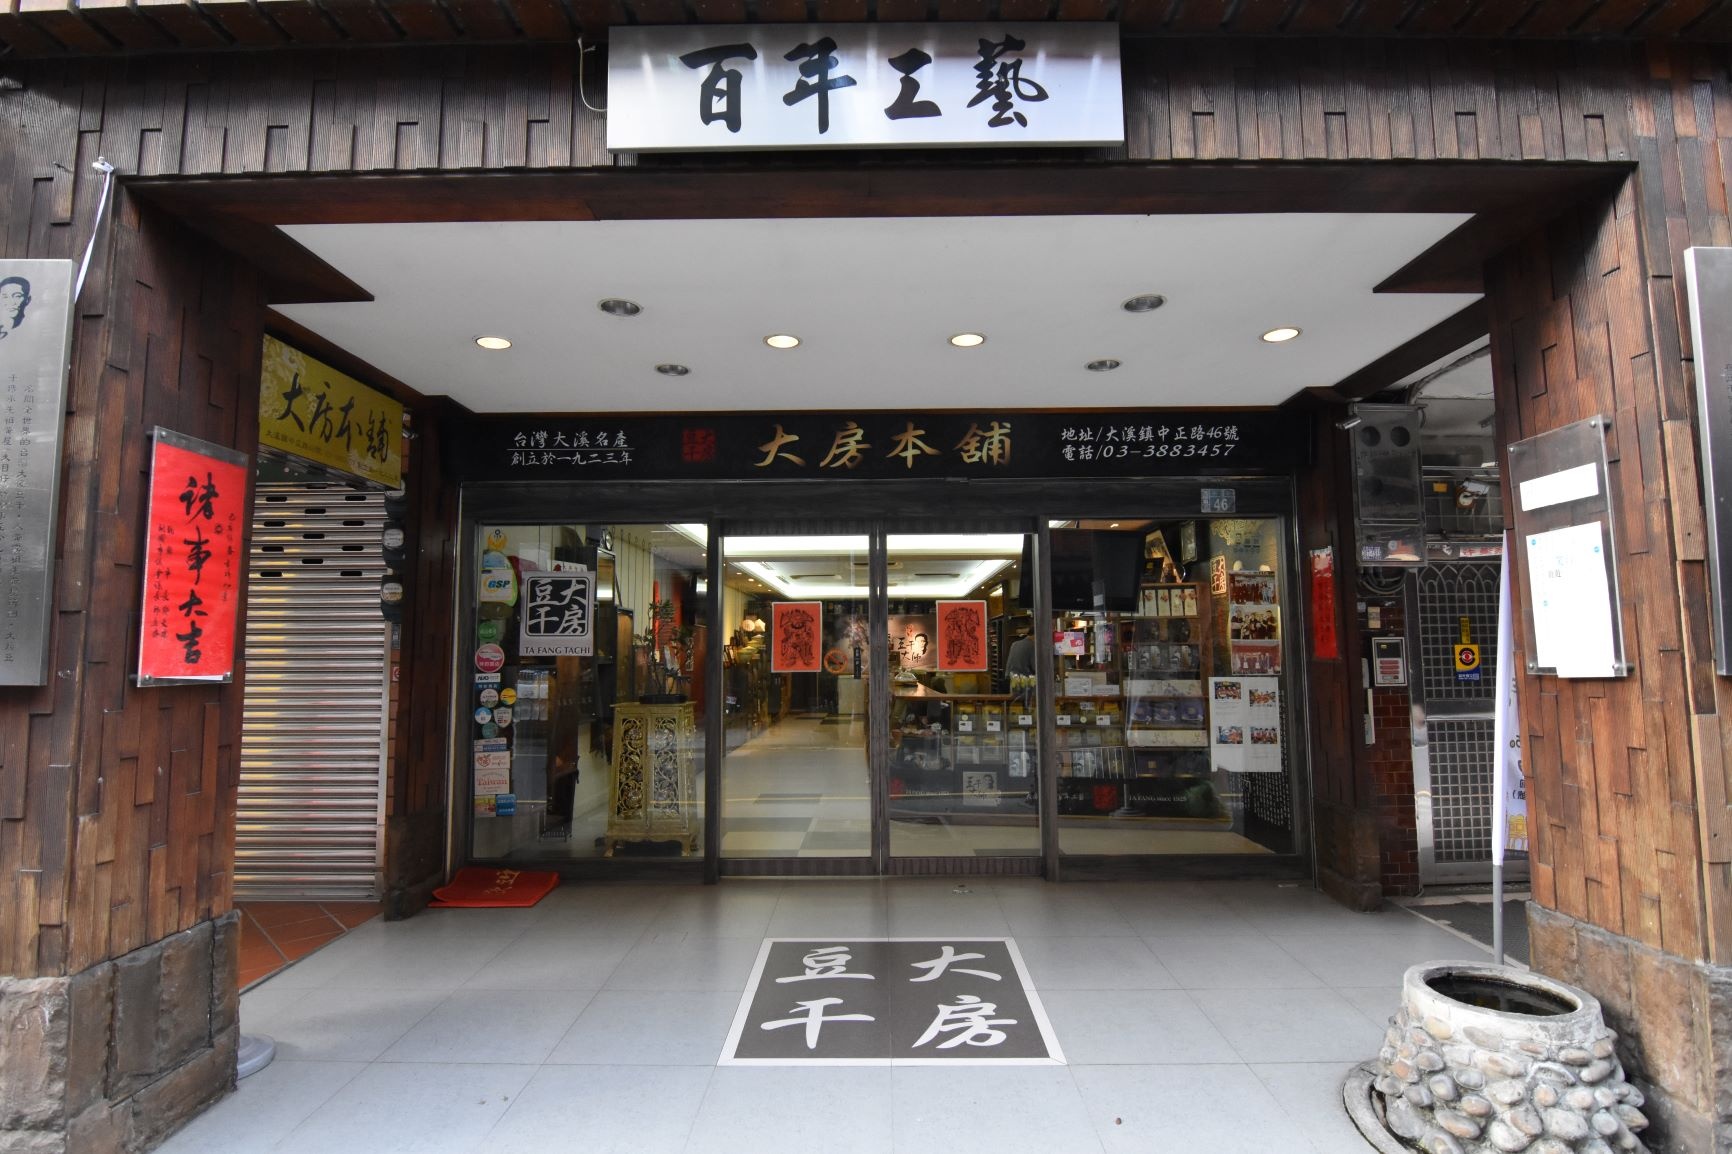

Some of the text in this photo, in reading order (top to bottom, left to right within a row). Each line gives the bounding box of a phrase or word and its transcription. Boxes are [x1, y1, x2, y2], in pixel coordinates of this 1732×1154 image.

[679, 34, 1049, 134] 百年工藝
[511, 451, 633, 465] 創立於一九二三年
[514, 430, 629, 448] 台灣大溪名產
[1214, 498, 1228, 511] 46
[176, 472, 219, 664] 諸事大吉
[488, 580, 510, 589] GSP
[529, 579, 560, 634] 豆干
[555, 579, 587, 634] 大房
[760, 946, 876, 1049] 豆干
[909, 945, 1018, 1049] 大房
